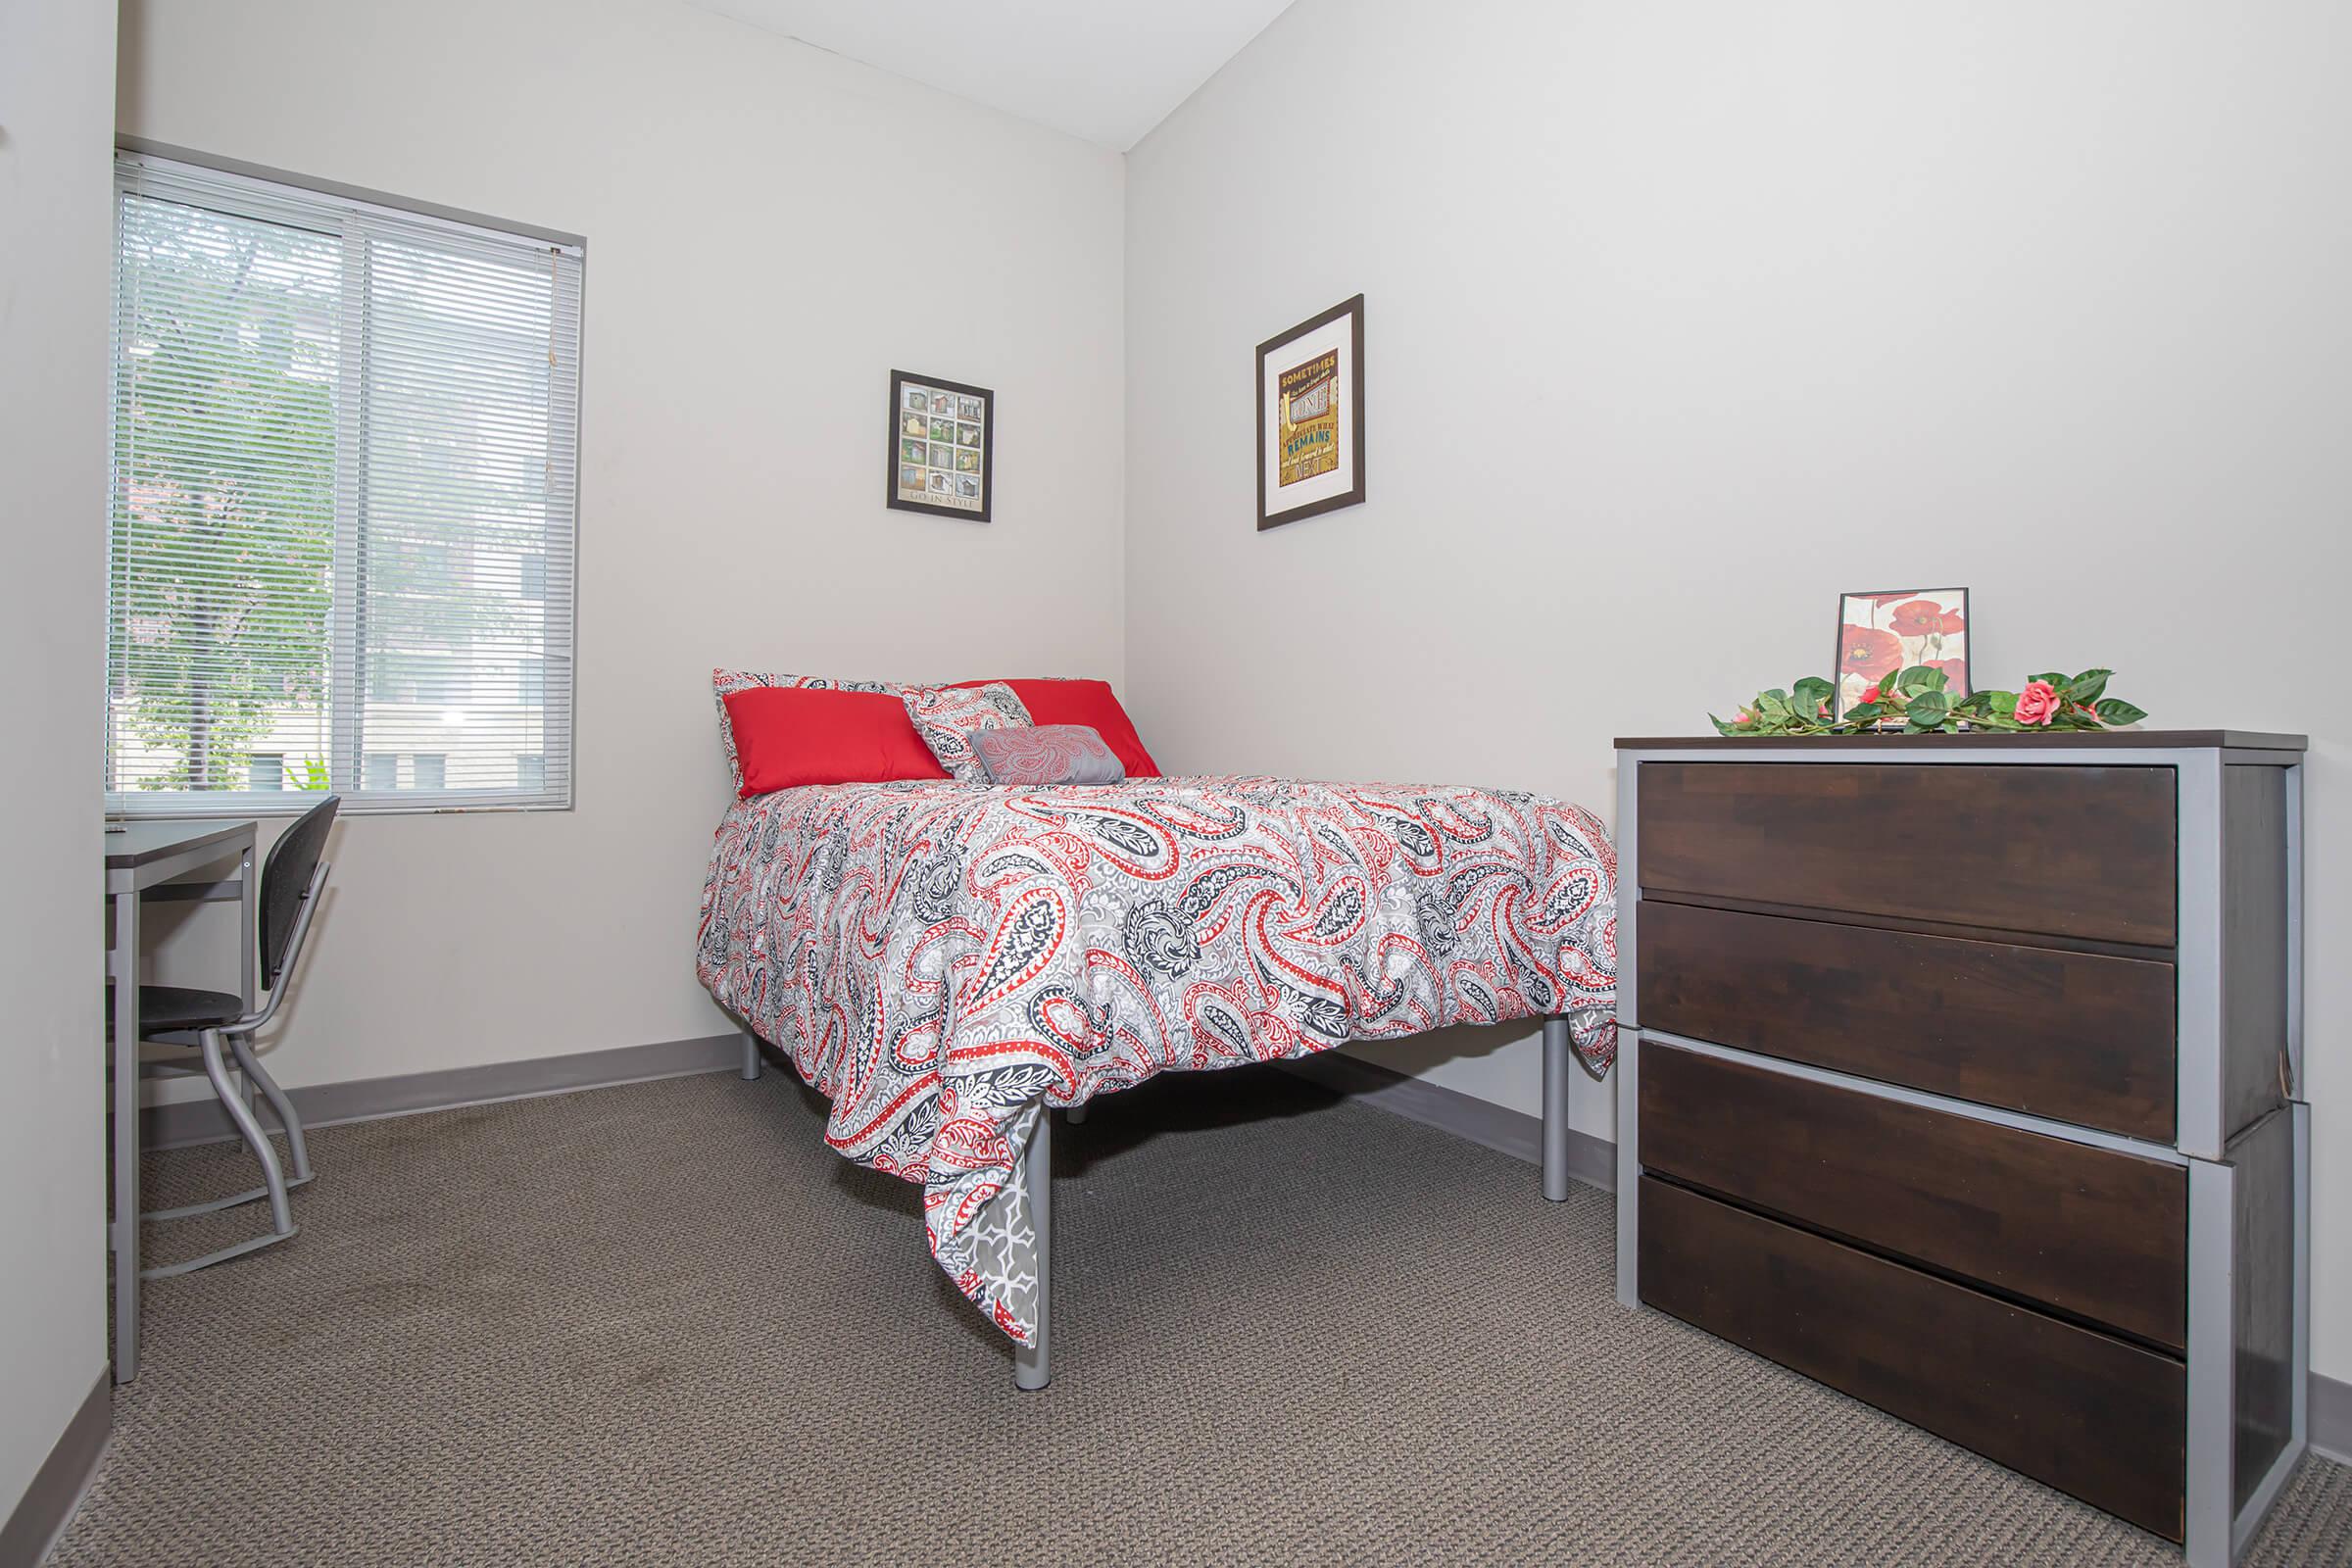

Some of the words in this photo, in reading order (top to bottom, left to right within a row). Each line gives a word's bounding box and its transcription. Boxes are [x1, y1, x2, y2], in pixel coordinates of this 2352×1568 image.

[1282, 356, 1335, 387] SOMETIMES
[1288, 430, 1331, 456] REMAINS
[1296, 458, 1321, 477] NEXT
[910, 491, 927, 501] GO
[947, 497, 973, 508] STYLE
